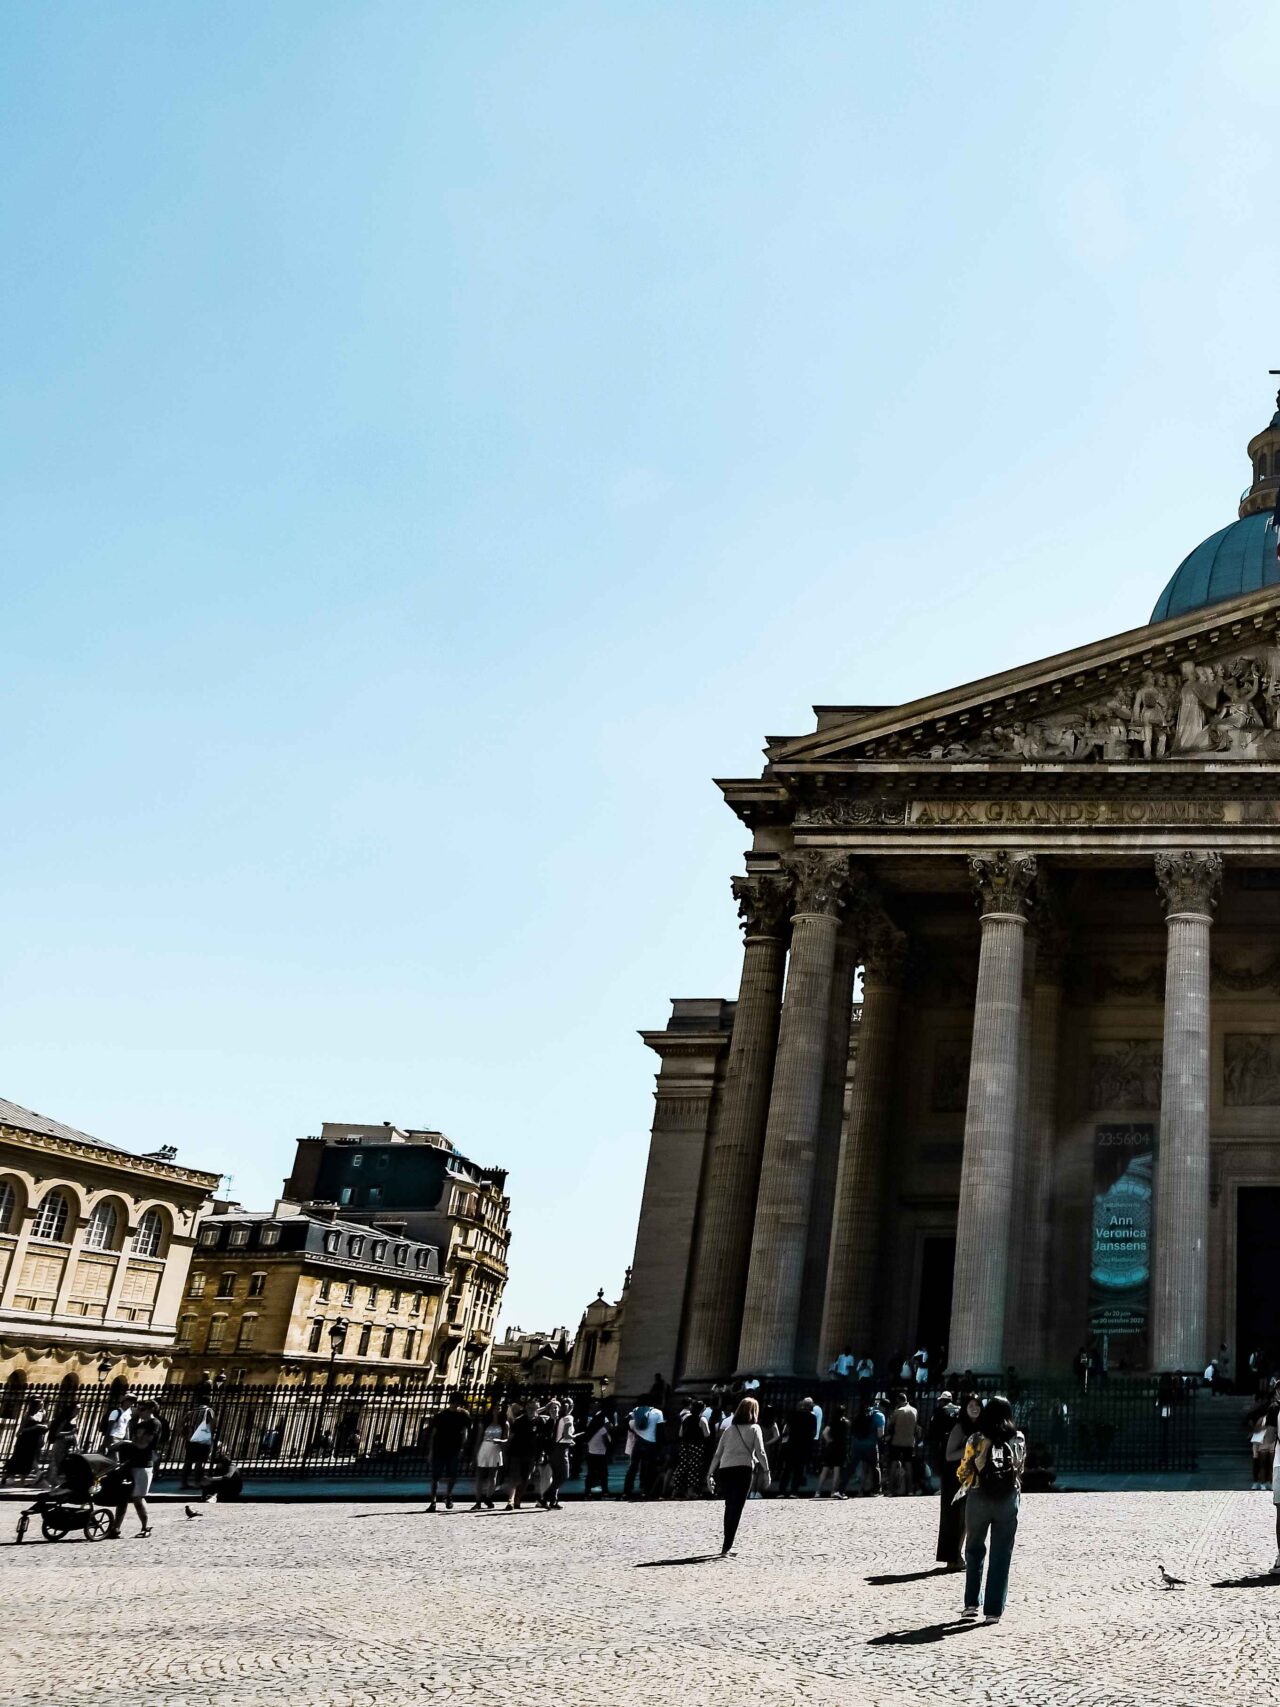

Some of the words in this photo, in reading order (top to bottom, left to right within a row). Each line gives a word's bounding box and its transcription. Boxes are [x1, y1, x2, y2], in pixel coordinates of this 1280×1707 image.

[915, 802, 977, 821] AUX
[983, 802, 1099, 822] GRANDS
[1105, 802, 1223, 821] HOMMES
[1241, 802, 1277, 821] LA
[1098, 1132, 1151, 1146] 23:56:04
[1109, 1215, 1133, 1226] Ann
[1095, 1227, 1147, 1238] Veronica
[1094, 1240, 1147, 1251] Janssens
